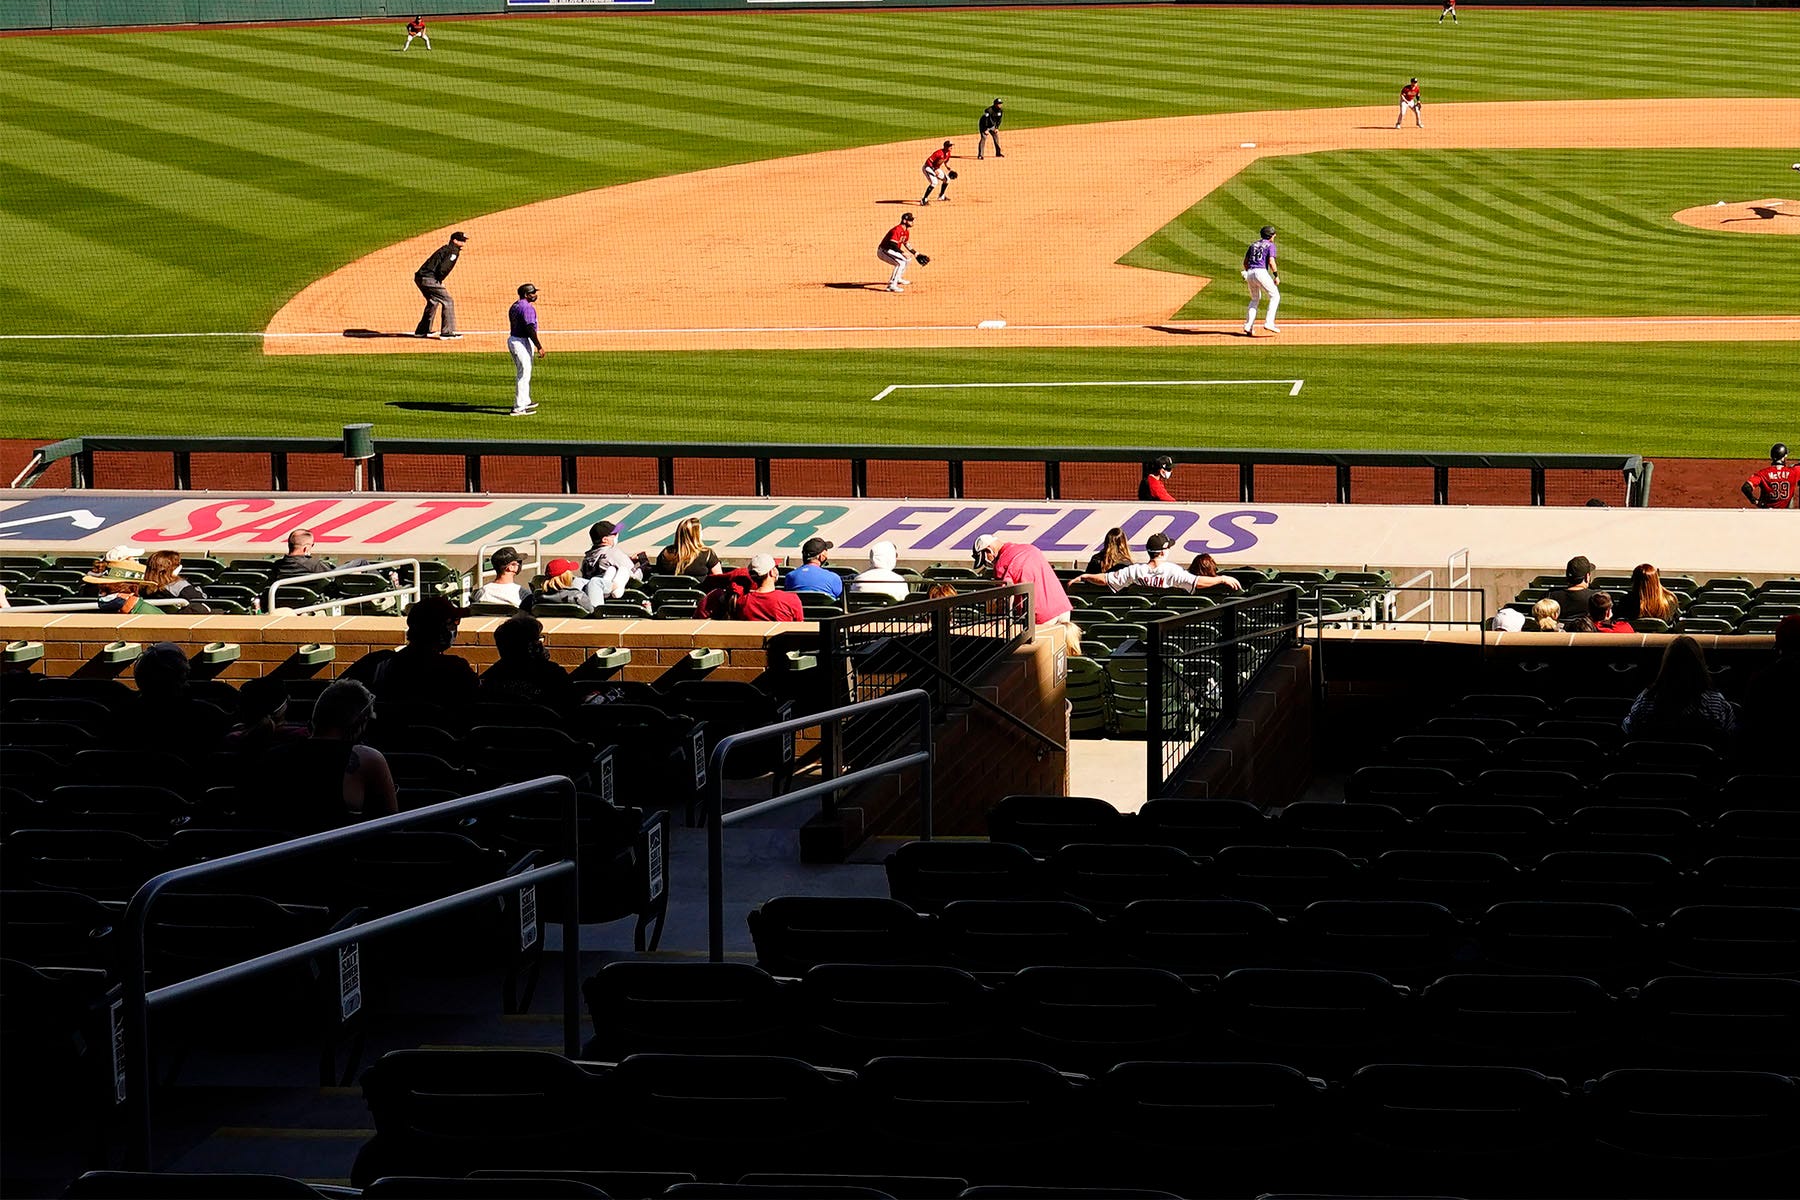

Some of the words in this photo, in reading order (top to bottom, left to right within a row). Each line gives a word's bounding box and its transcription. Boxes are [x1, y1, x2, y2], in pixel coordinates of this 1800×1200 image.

[1770, 481, 1790, 500] 39
[131, 499, 494, 544] SALT
[449, 501, 851, 548] RIVER
[841, 505, 1279, 555] FIELDS
